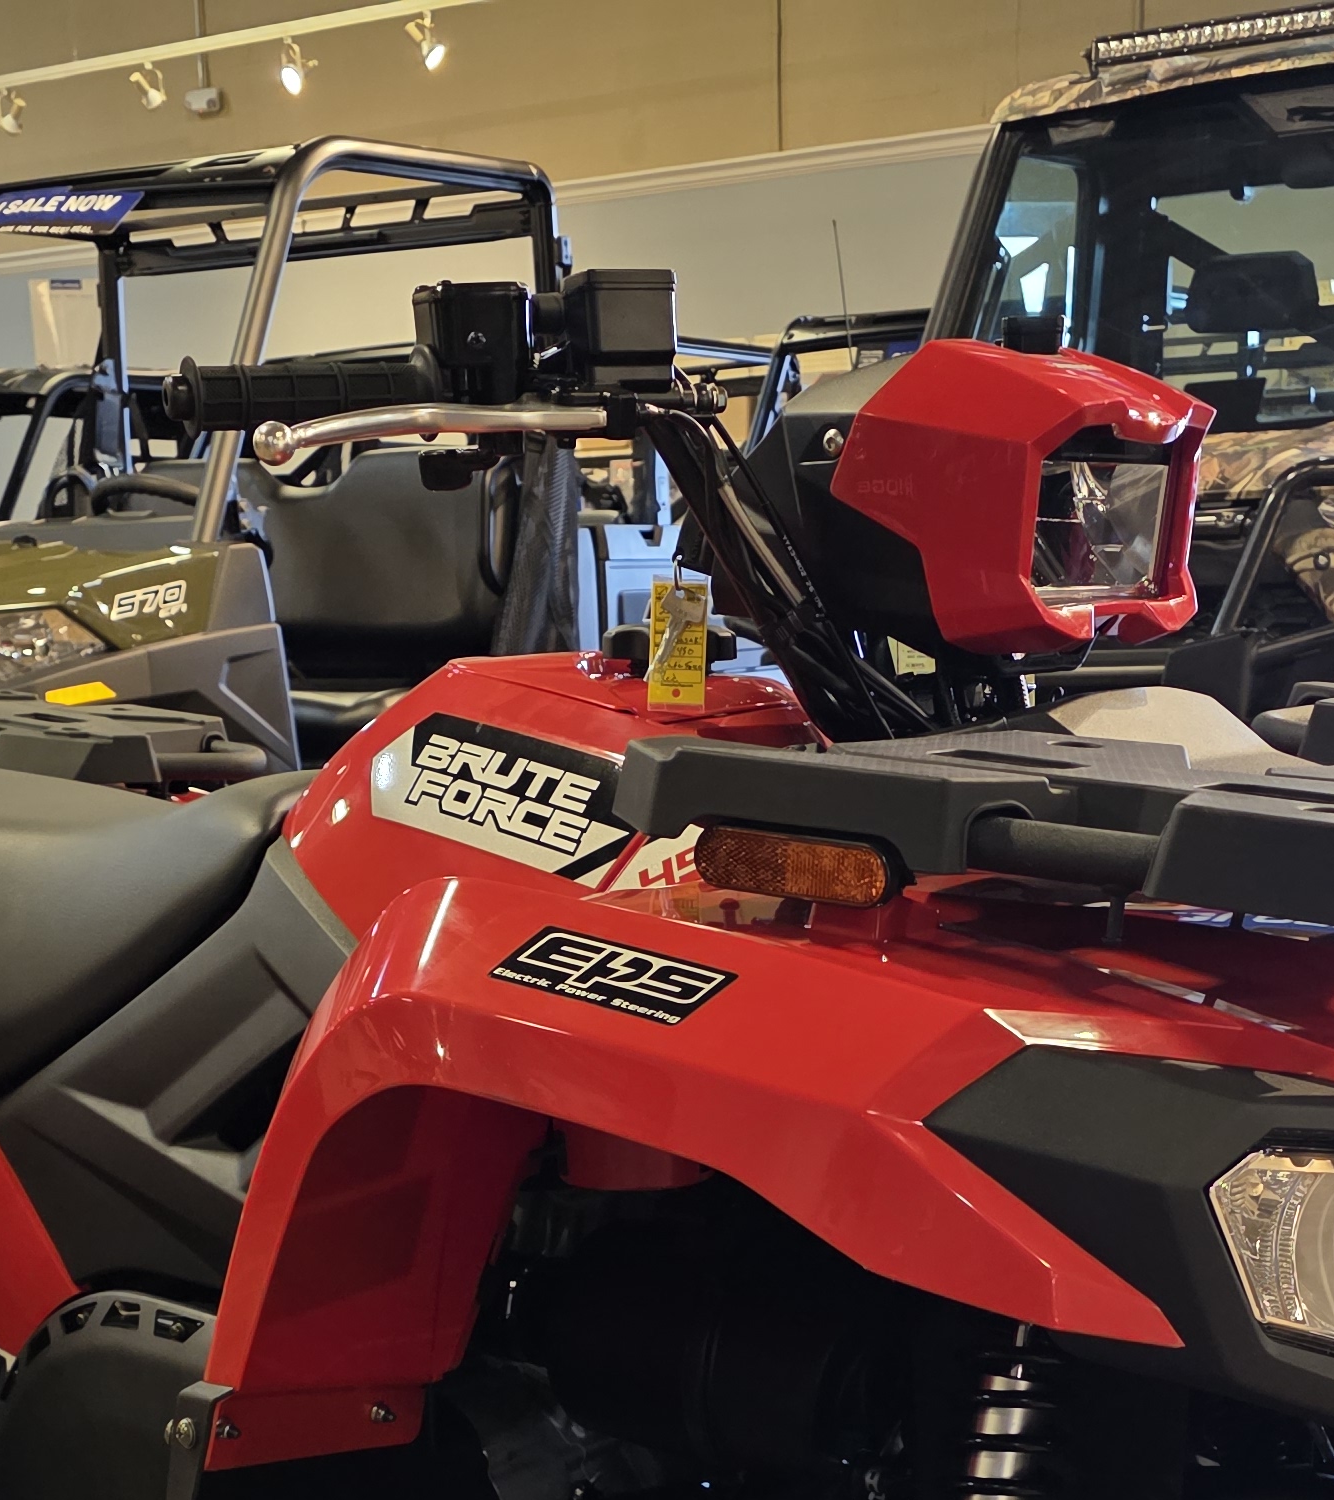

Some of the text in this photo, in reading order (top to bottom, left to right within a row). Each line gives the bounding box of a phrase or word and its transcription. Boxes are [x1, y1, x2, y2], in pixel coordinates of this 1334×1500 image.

[2, 195, 66, 214] SALE
[60, 194, 123, 212] NOW
[110, 580, 187, 621] 570
[415, 733, 601, 814] BRUTE
[406, 769, 589, 854] FORCE
[493, 966, 682, 1024] Electric Power Steering
[517, 932, 726, 1005] EPS
